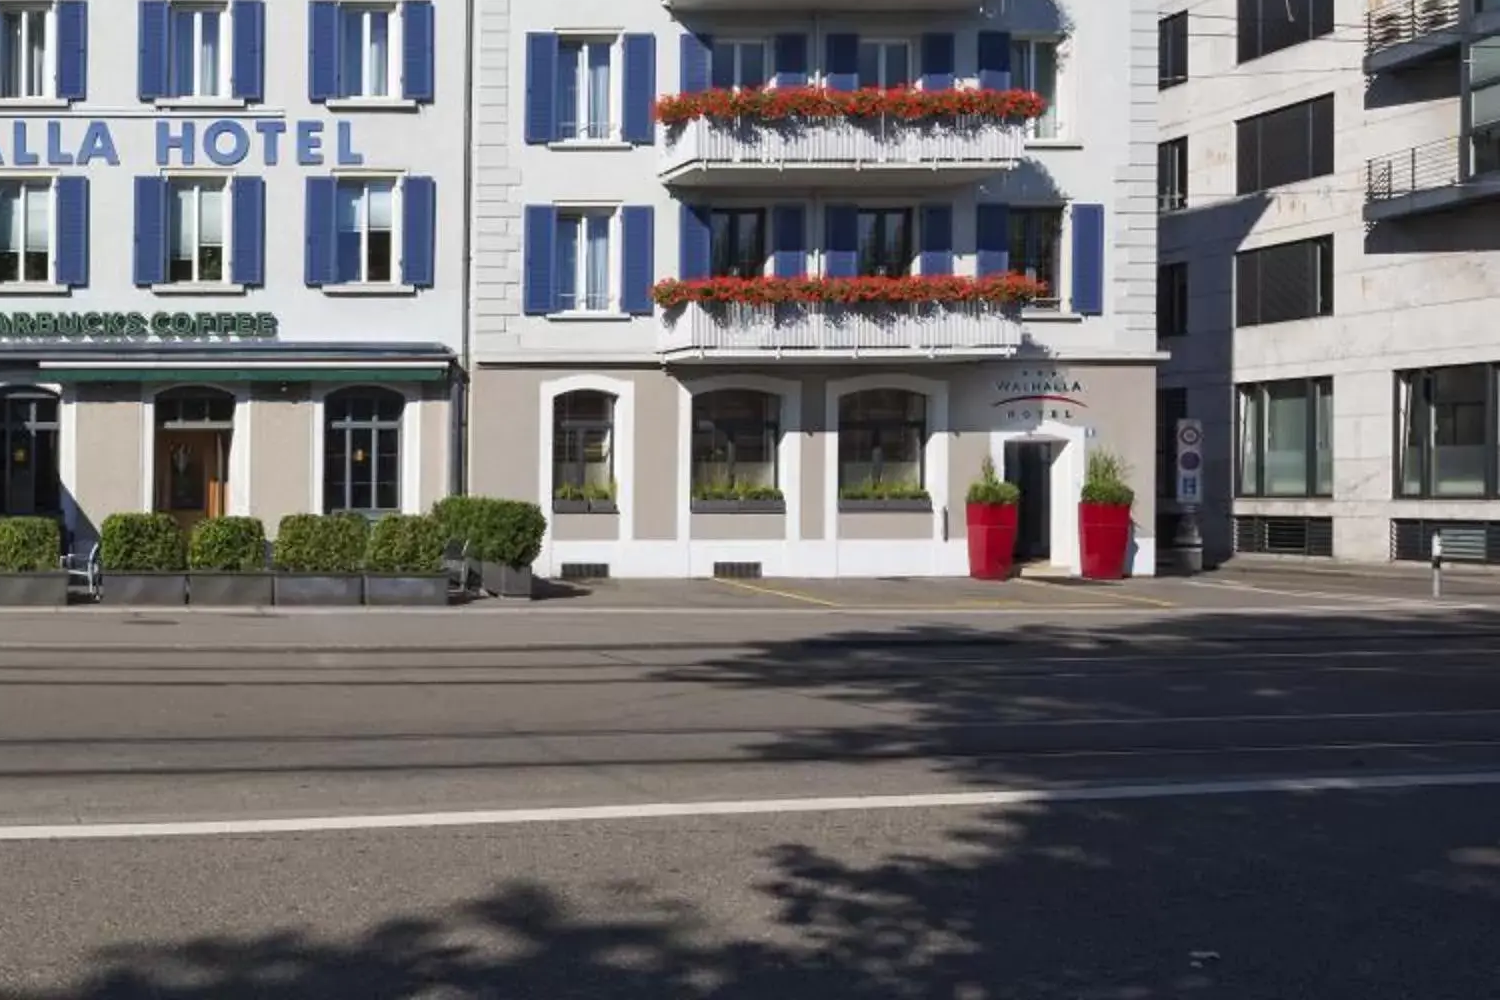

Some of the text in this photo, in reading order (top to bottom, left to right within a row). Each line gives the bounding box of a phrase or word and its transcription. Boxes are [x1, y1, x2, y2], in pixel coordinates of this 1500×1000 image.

[156, 119, 364, 167] HOTEL
[150, 312, 278, 338] COFFEE
[995, 381, 1082, 392] WALHALLA
[1007, 409, 1072, 419] HOTEL
